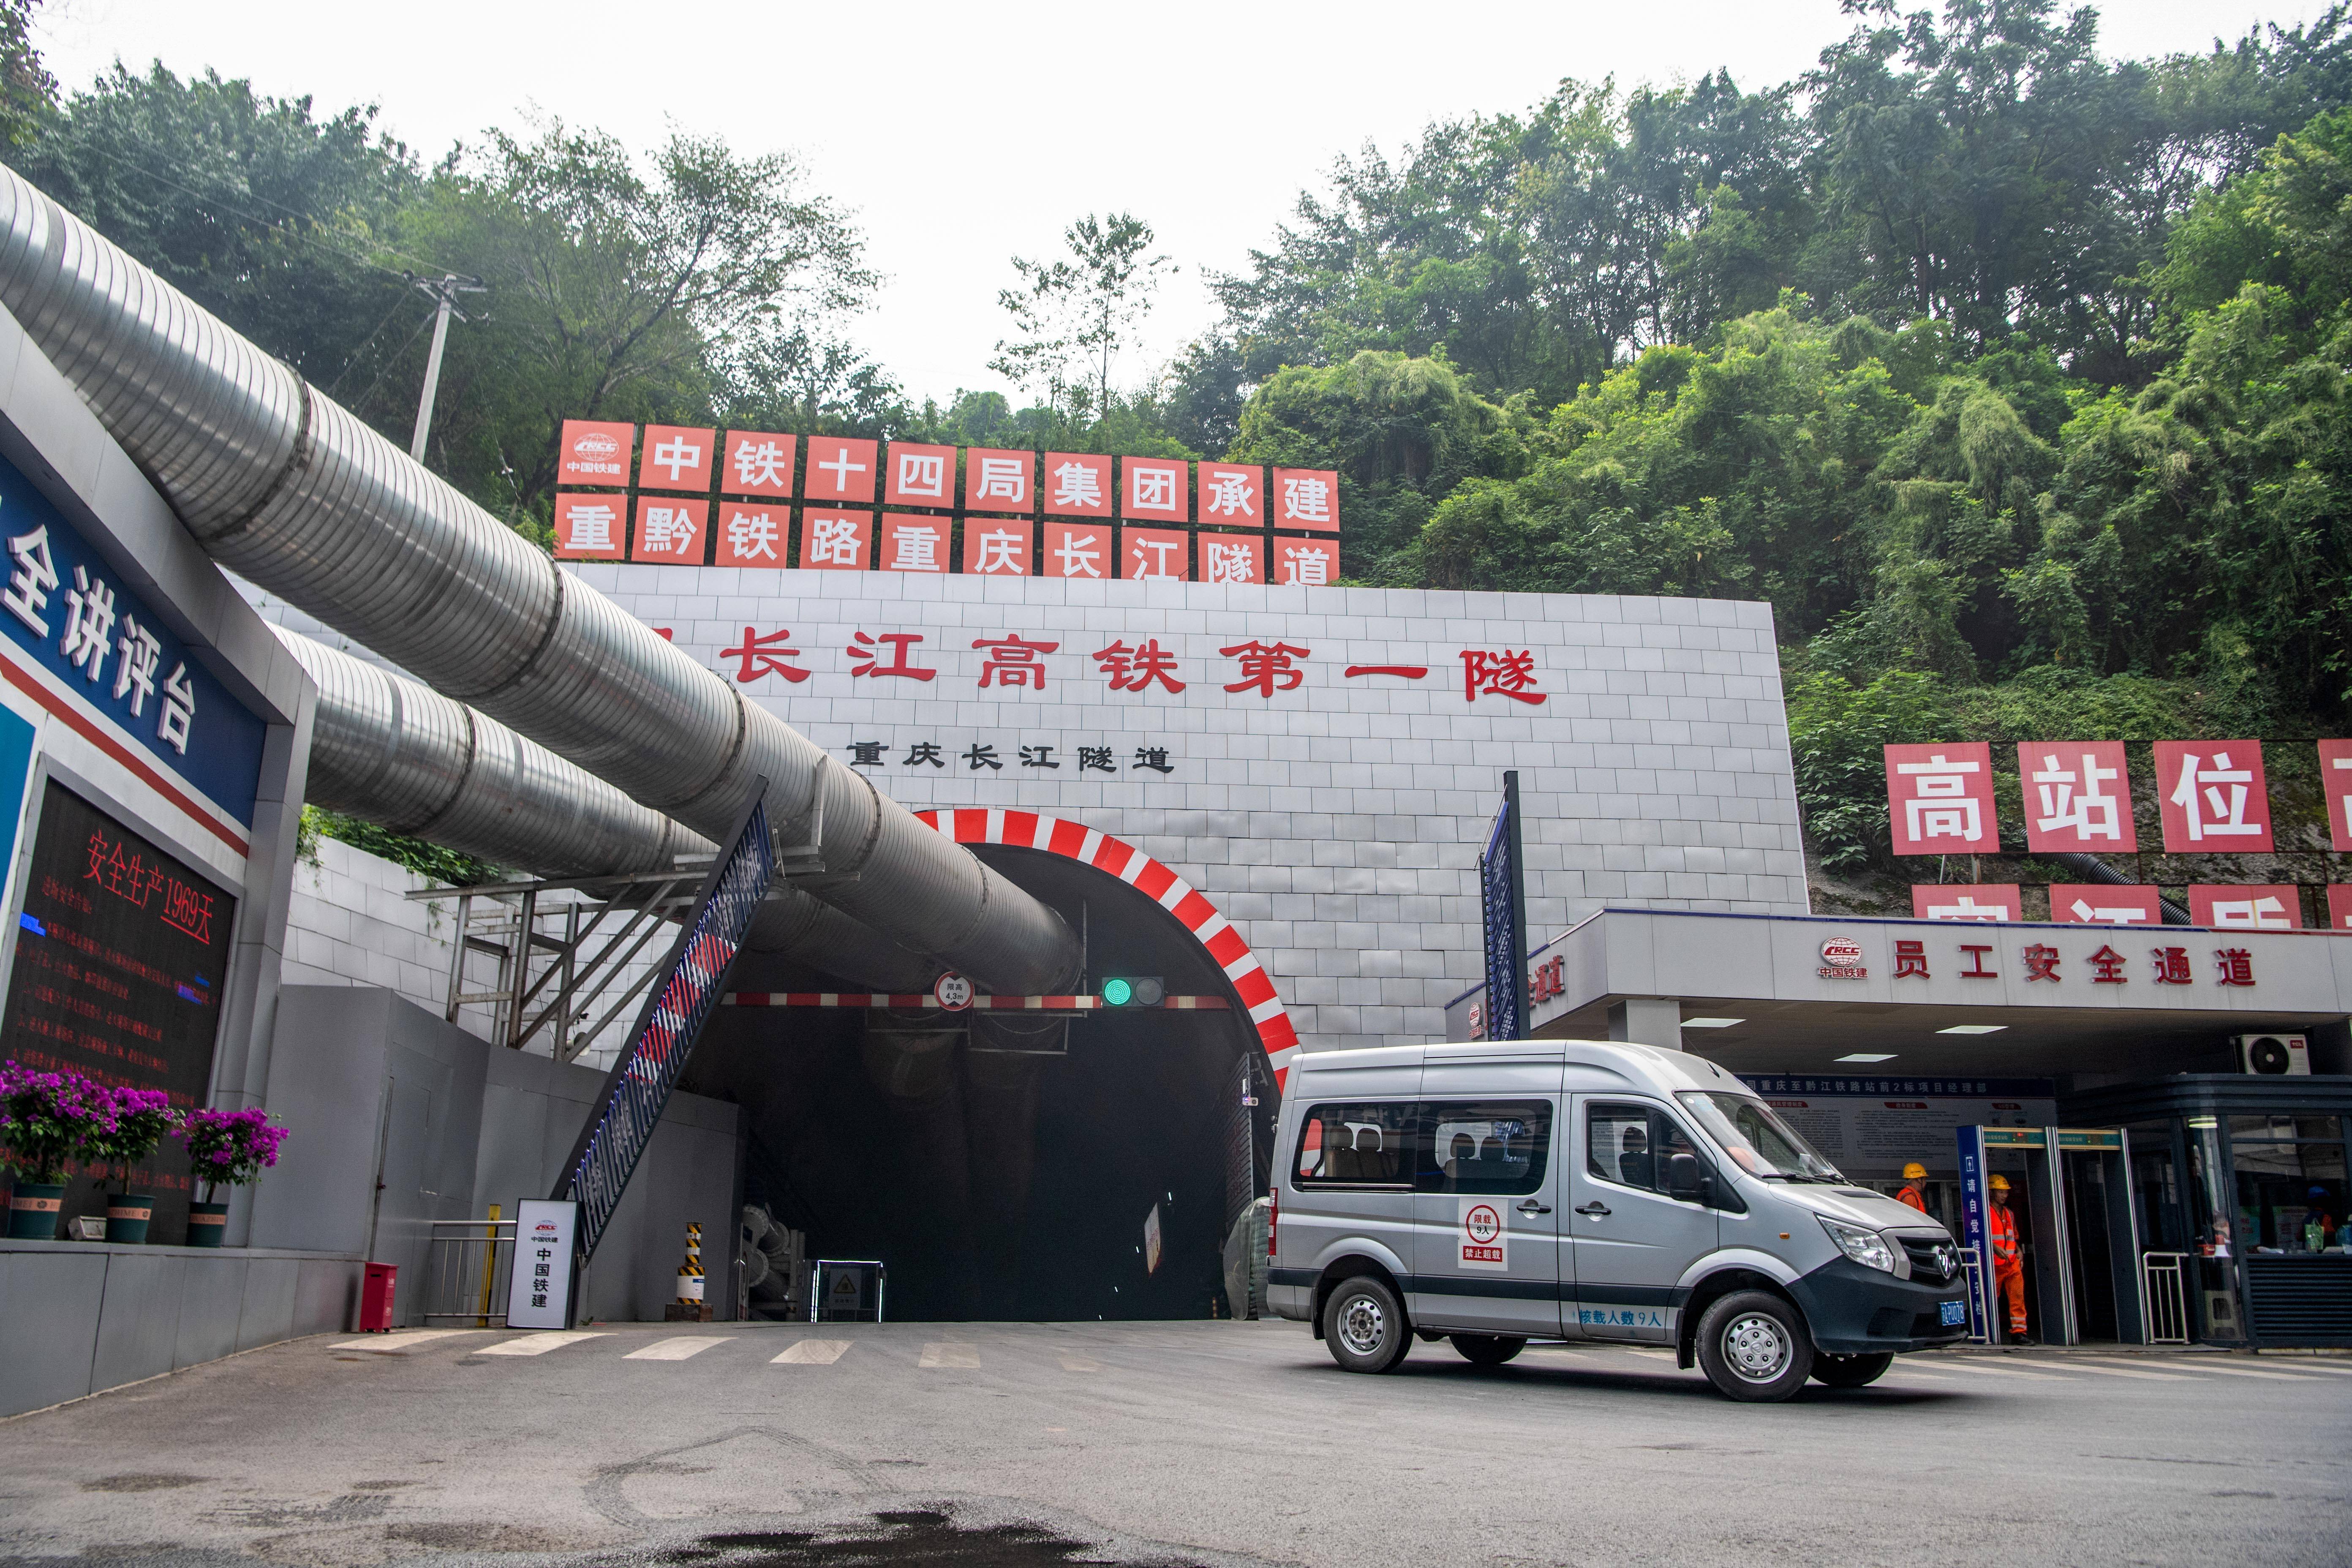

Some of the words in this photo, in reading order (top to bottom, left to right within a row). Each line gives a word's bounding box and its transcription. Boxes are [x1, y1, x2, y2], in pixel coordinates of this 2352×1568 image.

[567, 461, 621, 474] 中国铁建
[654, 436, 1330, 522] 中铁十四局集团承建
[564, 505, 1329, 586] 重黔铁路重庆长江隧道
[653, 626, 1547, 705] 长江高铁第一隧
[846, 741, 1174, 773] 重庆长江隧道
[83, 829, 213, 939] 安全生产1969天
[1819, 966, 1868, 978] 中国铁建
[1894, 940, 2257, 986] 员工安全通道
[947, 983, 963, 991] 限高
[1474, 1214, 1491, 1224] 限载
[1477, 1226, 1489, 1235] 9人
[1465, 1248, 1500, 1260] 禁止超载
[531, 1248, 551, 1308] 中国铁建
[1579, 1309, 1662, 1327] 核载人数9人
